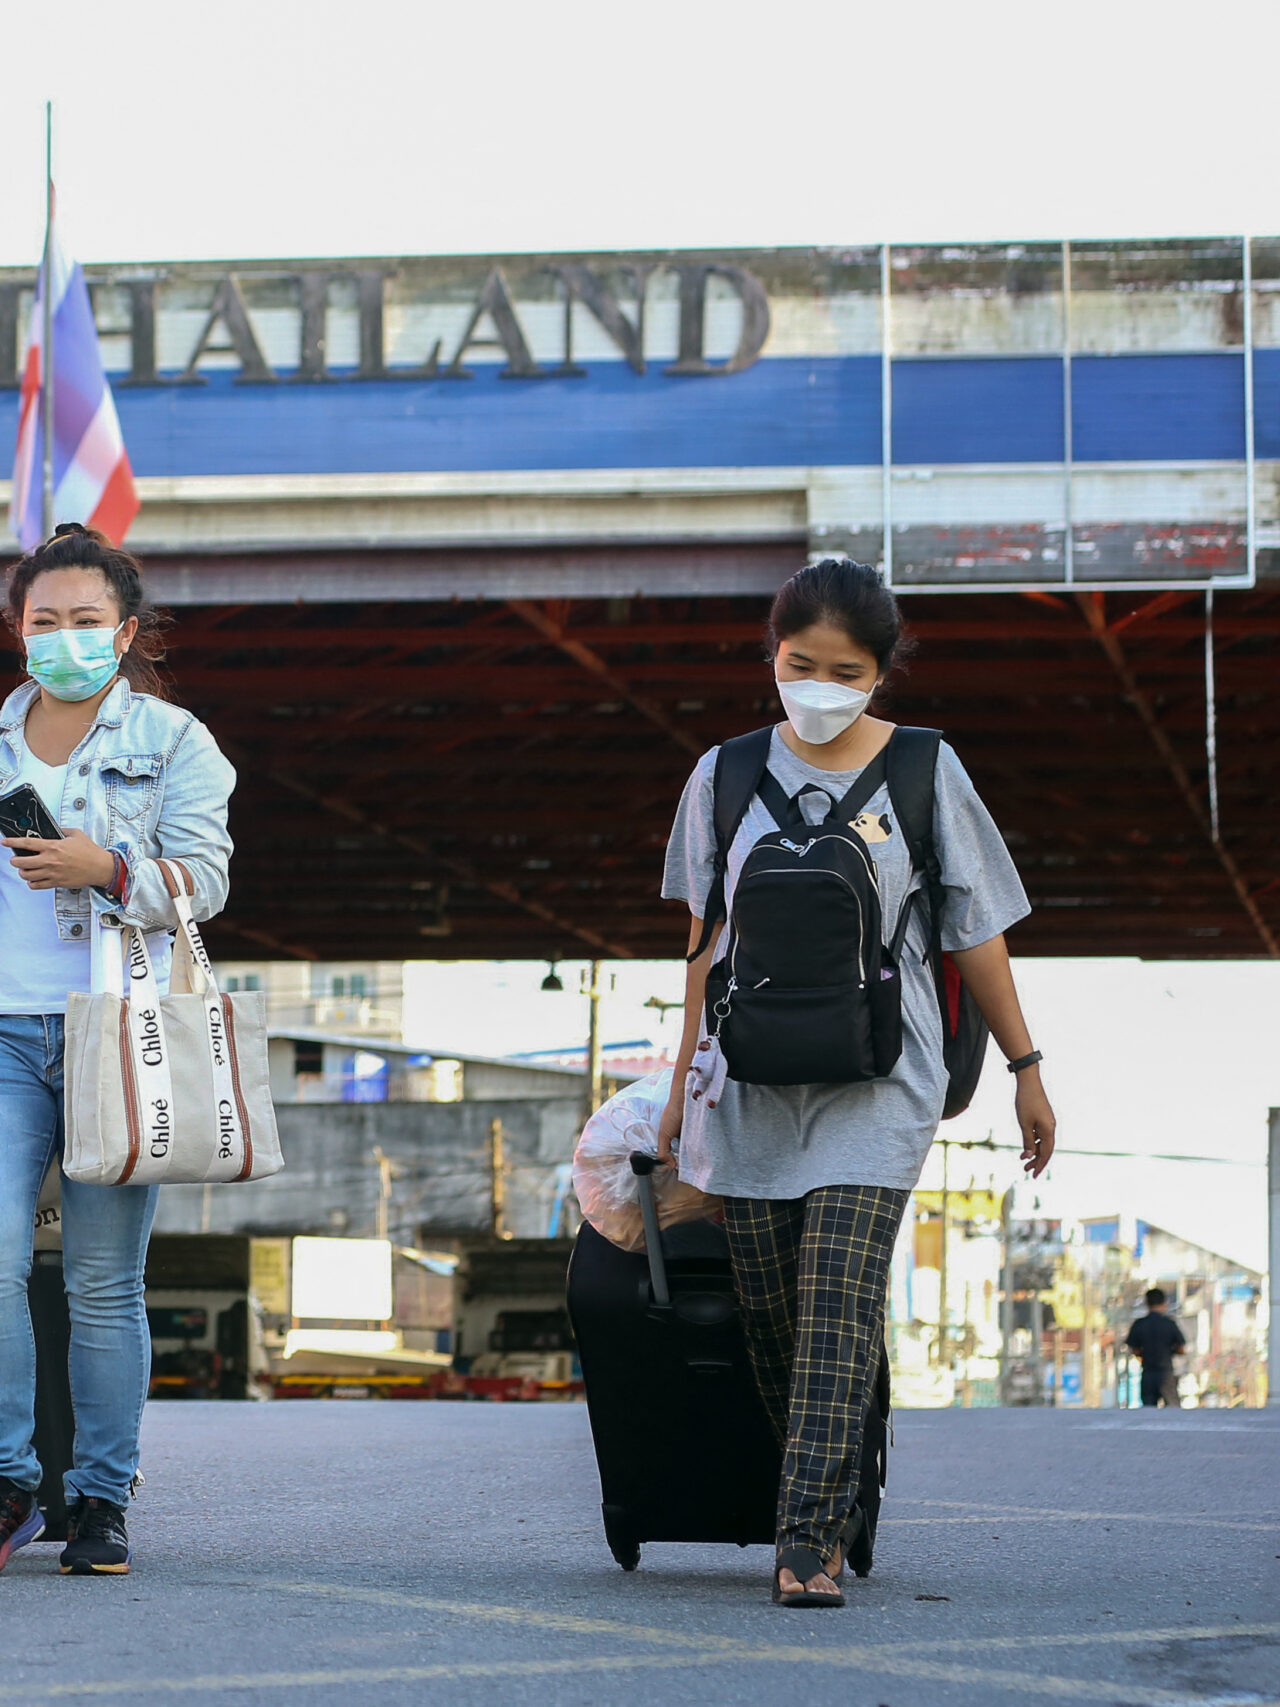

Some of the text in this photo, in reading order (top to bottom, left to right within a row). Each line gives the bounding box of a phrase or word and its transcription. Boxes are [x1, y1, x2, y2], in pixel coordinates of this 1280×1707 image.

[138, 1009, 163, 1066] Chloé
[210, 1007, 225, 1066] Chloé
[150, 1099, 169, 1158] Chloé
[218, 1099, 234, 1159] Chloé
